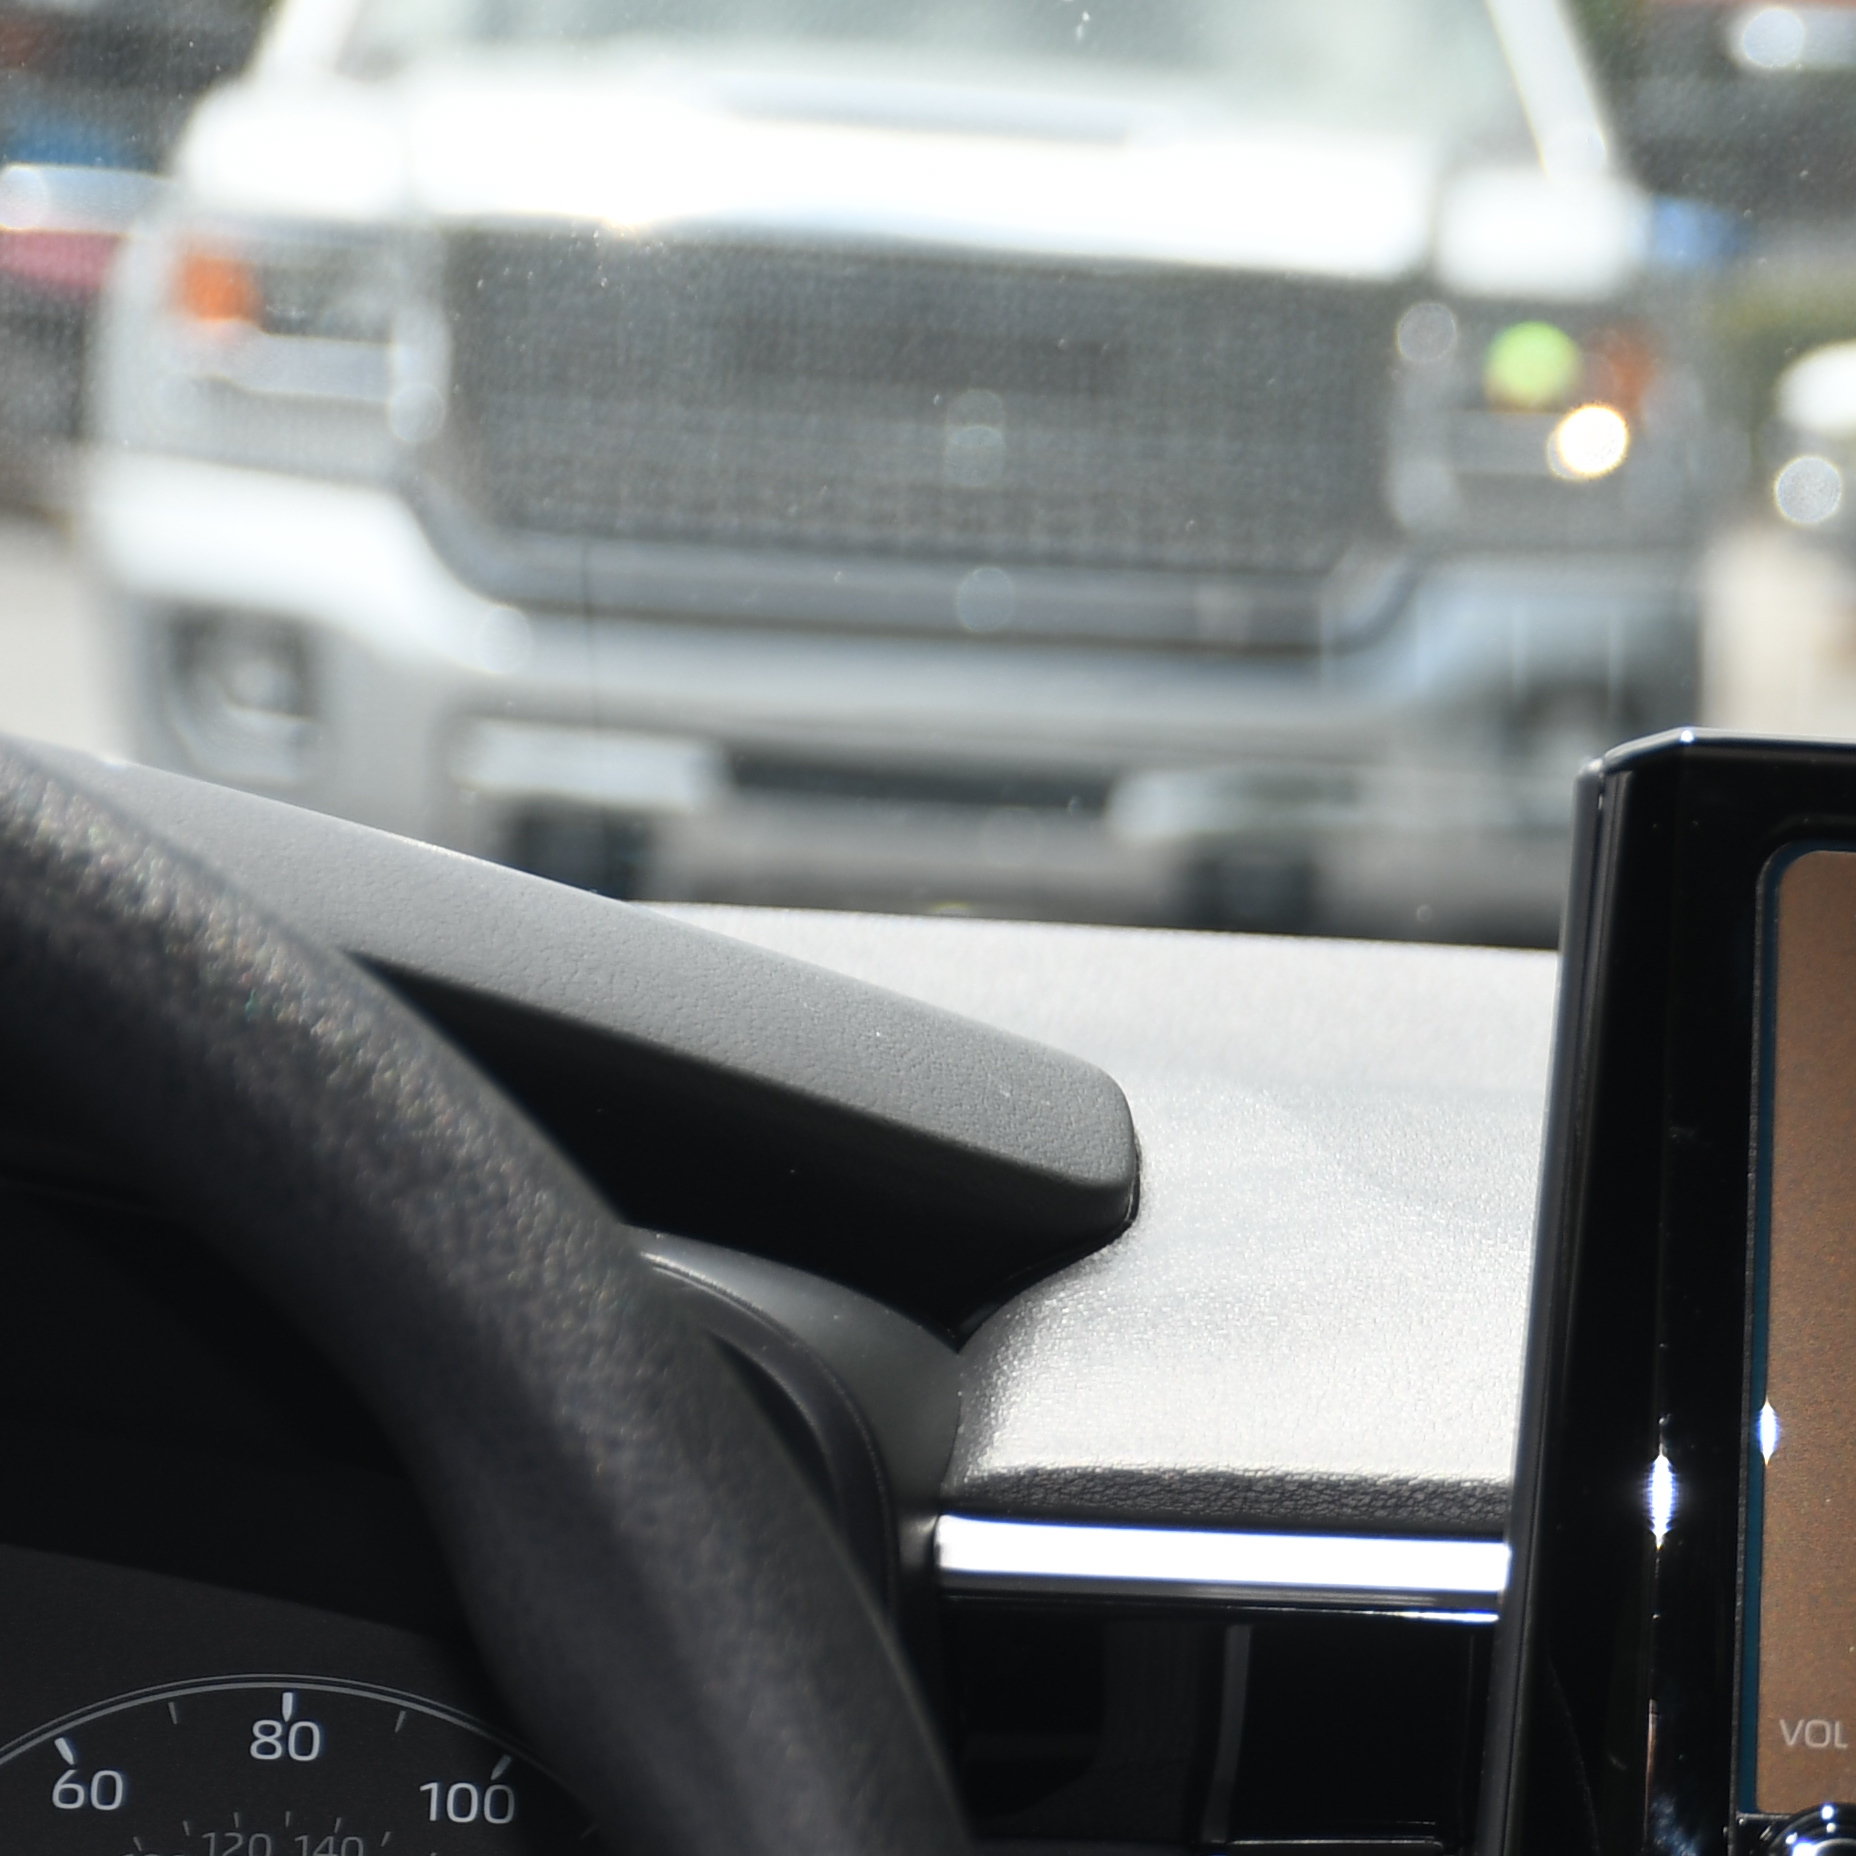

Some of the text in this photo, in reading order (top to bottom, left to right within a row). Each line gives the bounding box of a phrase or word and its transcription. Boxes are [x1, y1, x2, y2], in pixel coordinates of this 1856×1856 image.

[250, 1719, 321, 1762] 80
[1779, 1718, 1848, 1750] VOL
[51, 1770, 125, 1811] 60
[420, 1781, 517, 1824] 100
